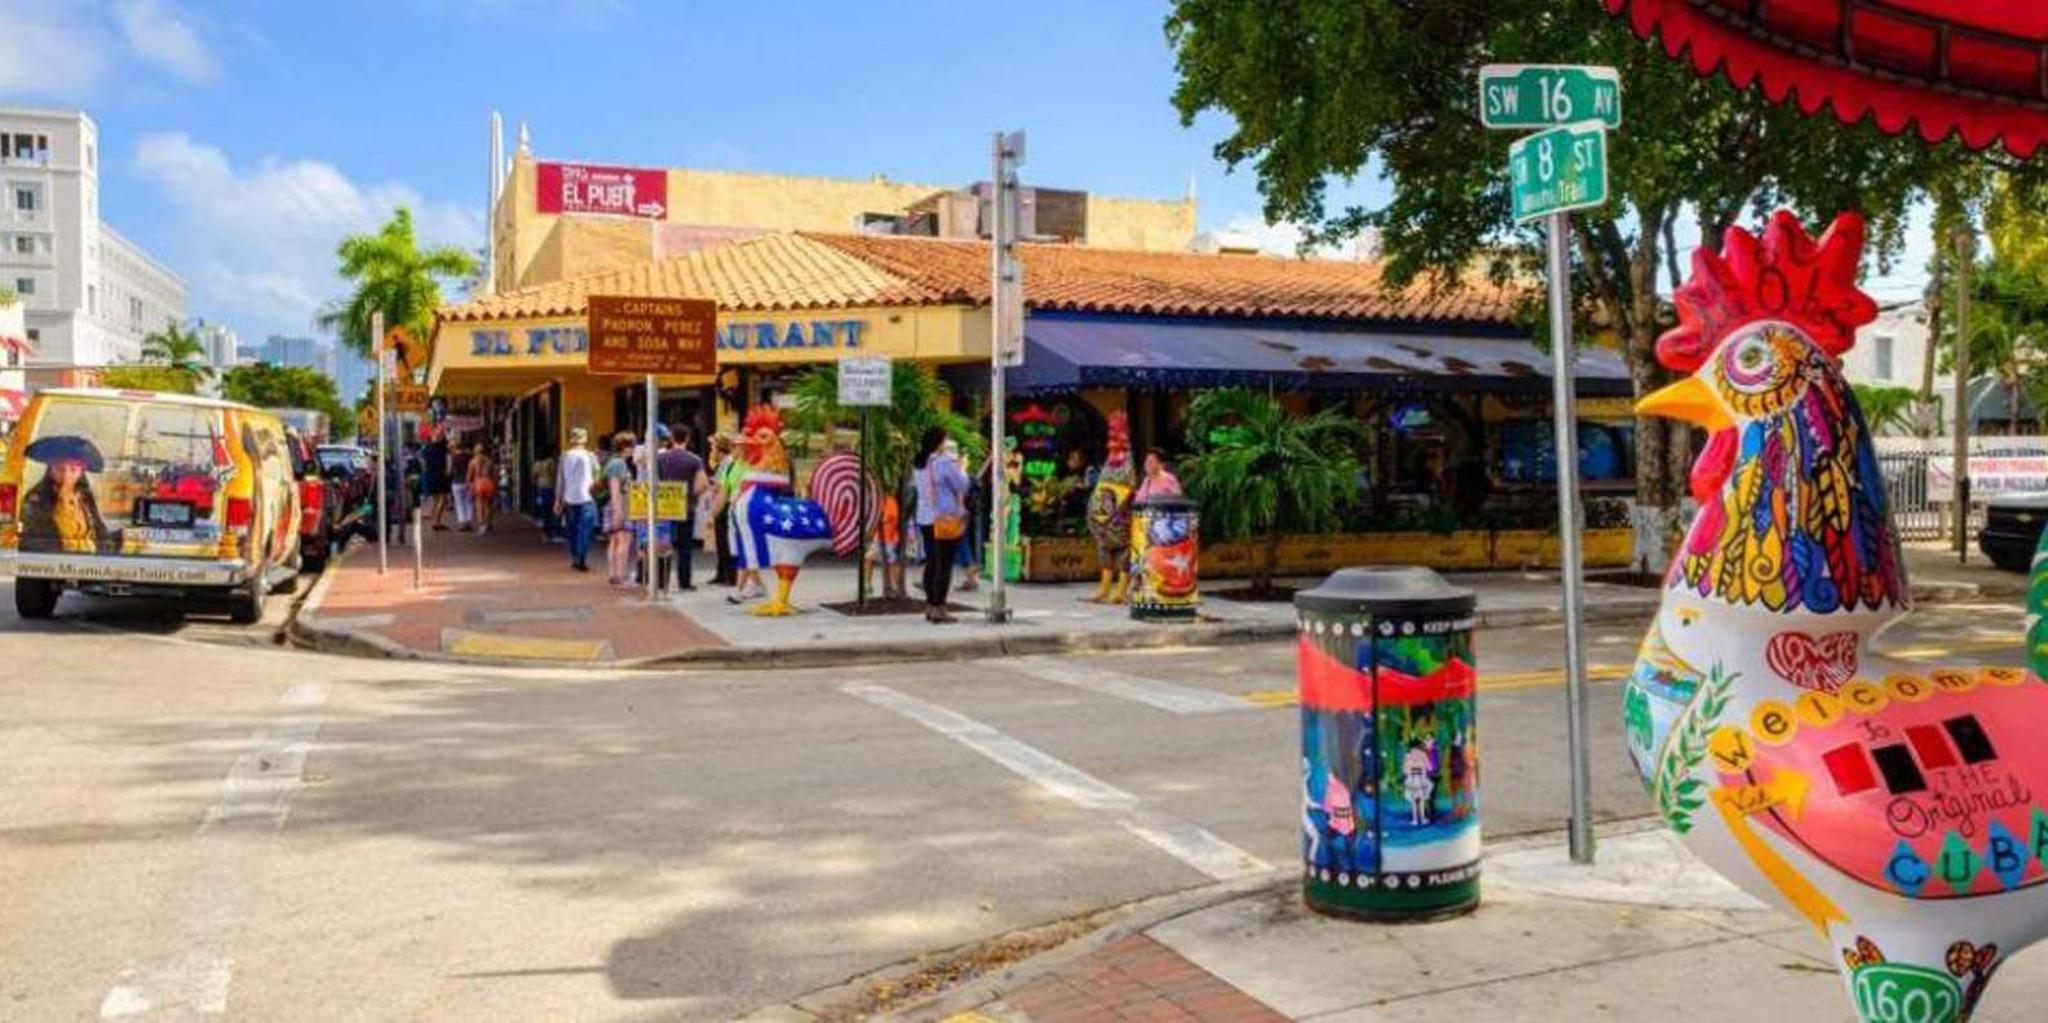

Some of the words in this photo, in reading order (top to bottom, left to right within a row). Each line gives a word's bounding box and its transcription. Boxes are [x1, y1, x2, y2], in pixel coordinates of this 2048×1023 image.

[1488, 85, 1519, 116] SW
[1539, 76, 1573, 121] 16
[1593, 86, 1614, 115] AV
[1538, 137, 1553, 182] 8
[1573, 138, 1595, 172] ST
[562, 182, 584, 205] EL
[471, 328, 514, 356] EL
[1713, 668, 2017, 768] Welcome
[1936, 764, 2000, 787] THE
[1886, 774, 2032, 839] Original
